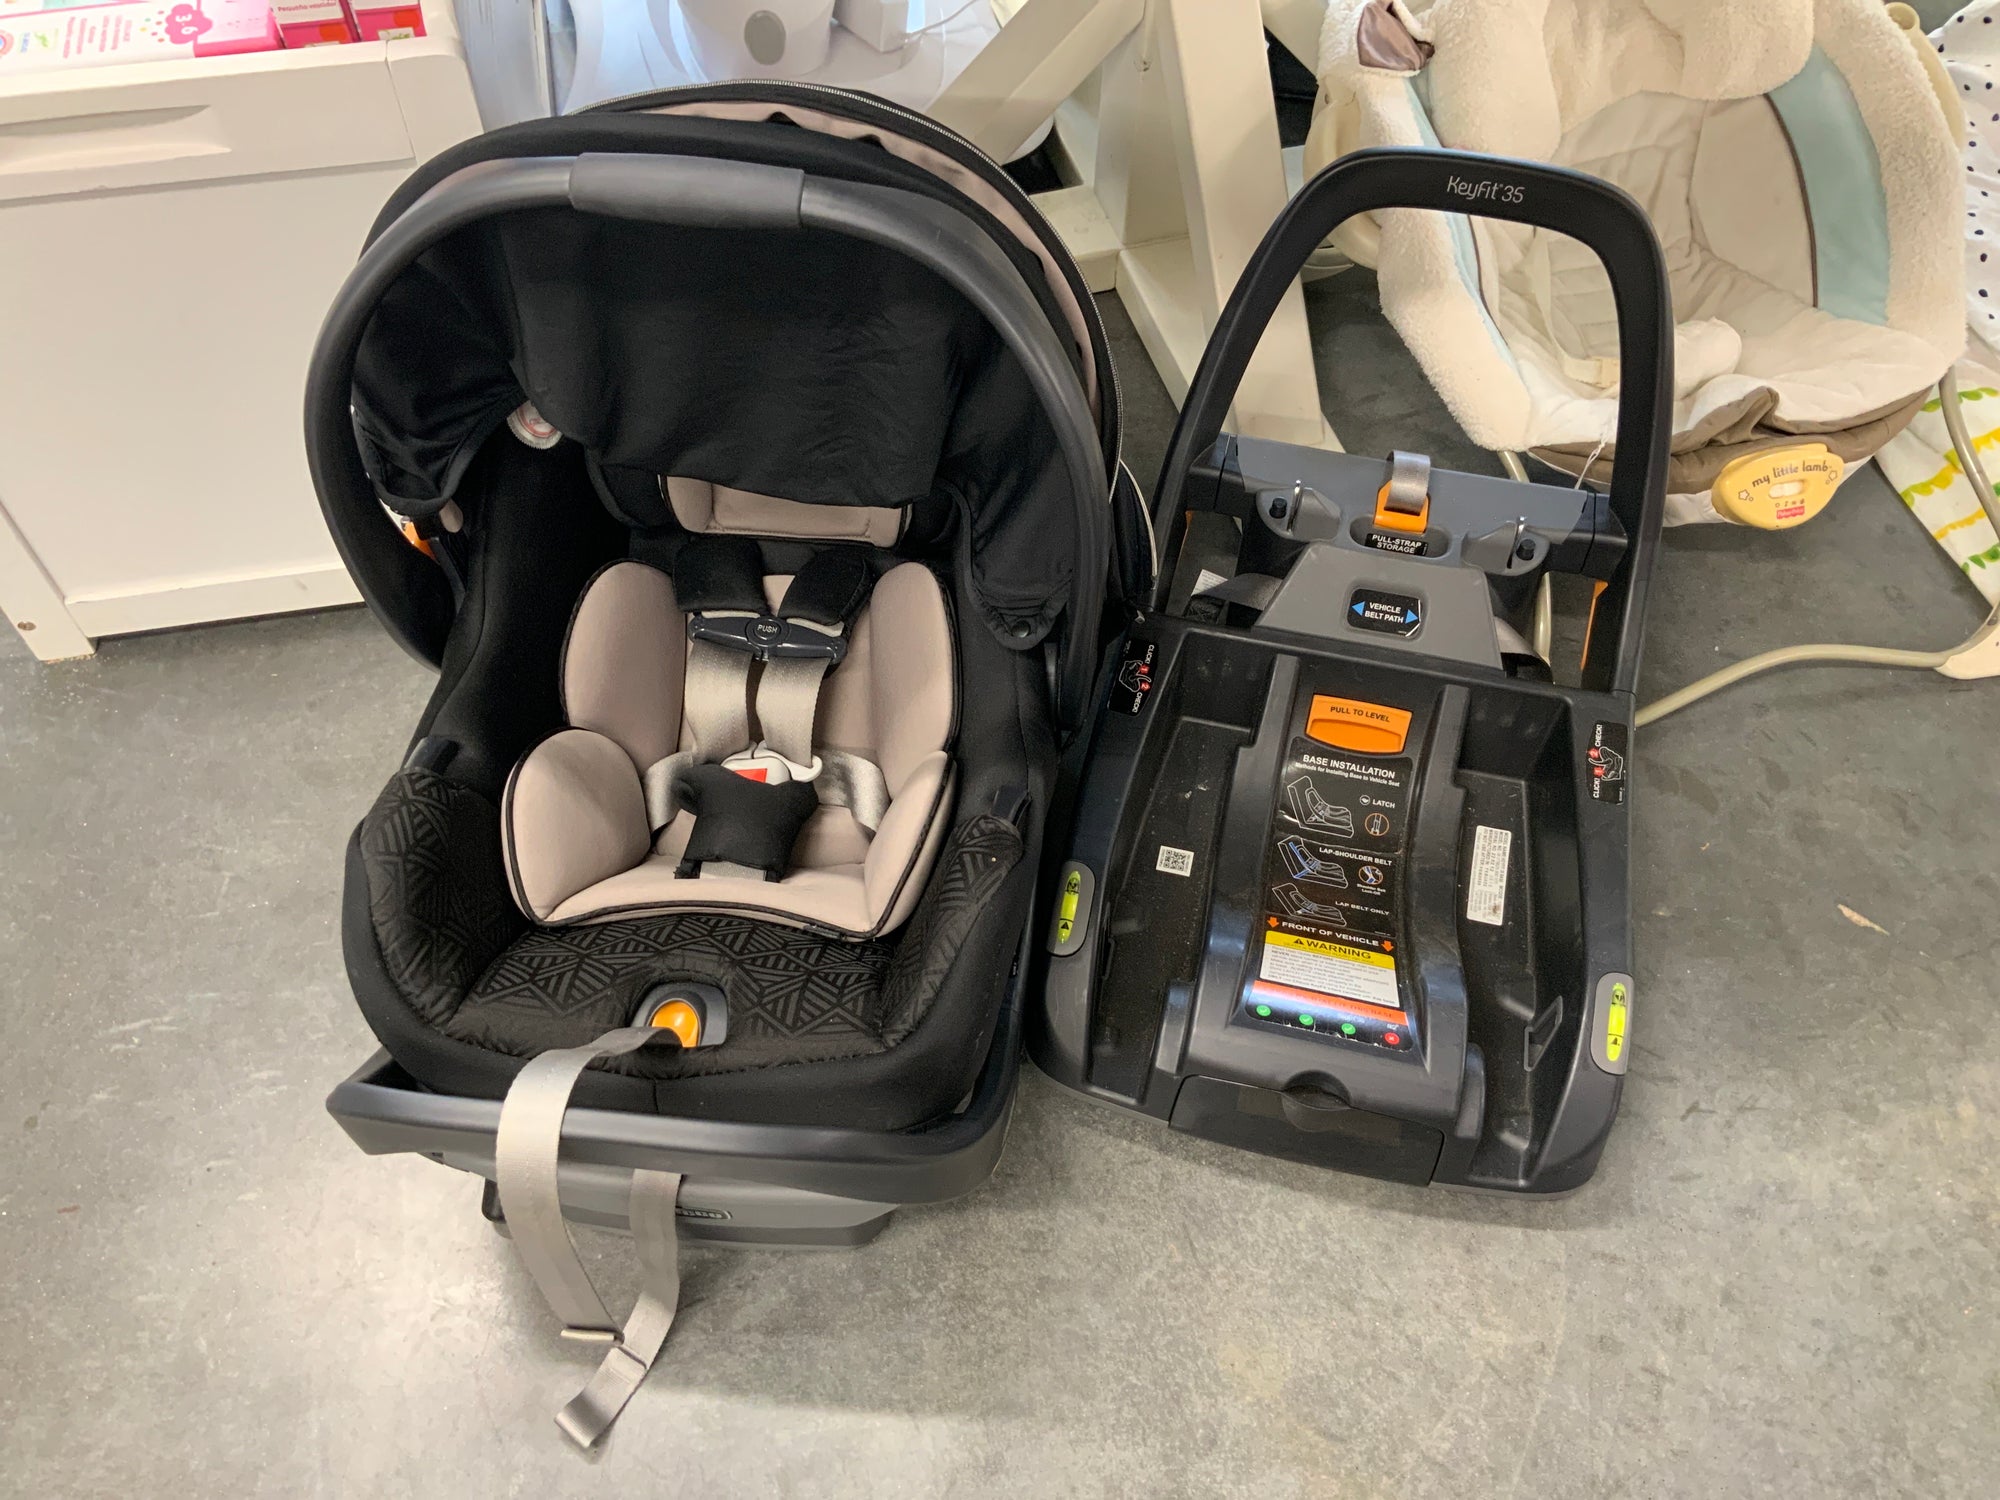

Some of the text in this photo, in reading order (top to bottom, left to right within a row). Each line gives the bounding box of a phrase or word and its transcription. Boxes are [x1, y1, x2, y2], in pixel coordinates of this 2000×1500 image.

[1446, 176, 1526, 203] KeyFit 35
[1752, 460, 1828, 488] my little lamb
[1372, 534, 1421, 548] PULL-STRAP
[1376, 542, 1415, 554] STORAGE
[1369, 602, 1401, 614] VEHICLE
[1364, 610, 1404, 623] BELT PATH
[757, 624, 778, 633] PUSH
[1330, 706, 1350, 715] PULL
[1366, 711, 1390, 722] LEVEL
[1296, 762, 1316, 771] Methods
[1326, 767, 1349, 778] Installing
[1370, 775, 1388, 785] Vehicle
[1303, 754, 1396, 779] BASE INSTALLATION
[1372, 799, 1396, 808] LATCH
[1320, 847, 1392, 866] LAP-SHOULDER BELT
[1370, 907, 1389, 916] ONLY
[1282, 921, 1316, 934] FRONT
[1335, 932, 1379, 946] VEHICLE
[1306, 940, 1371, 959] WARNING
